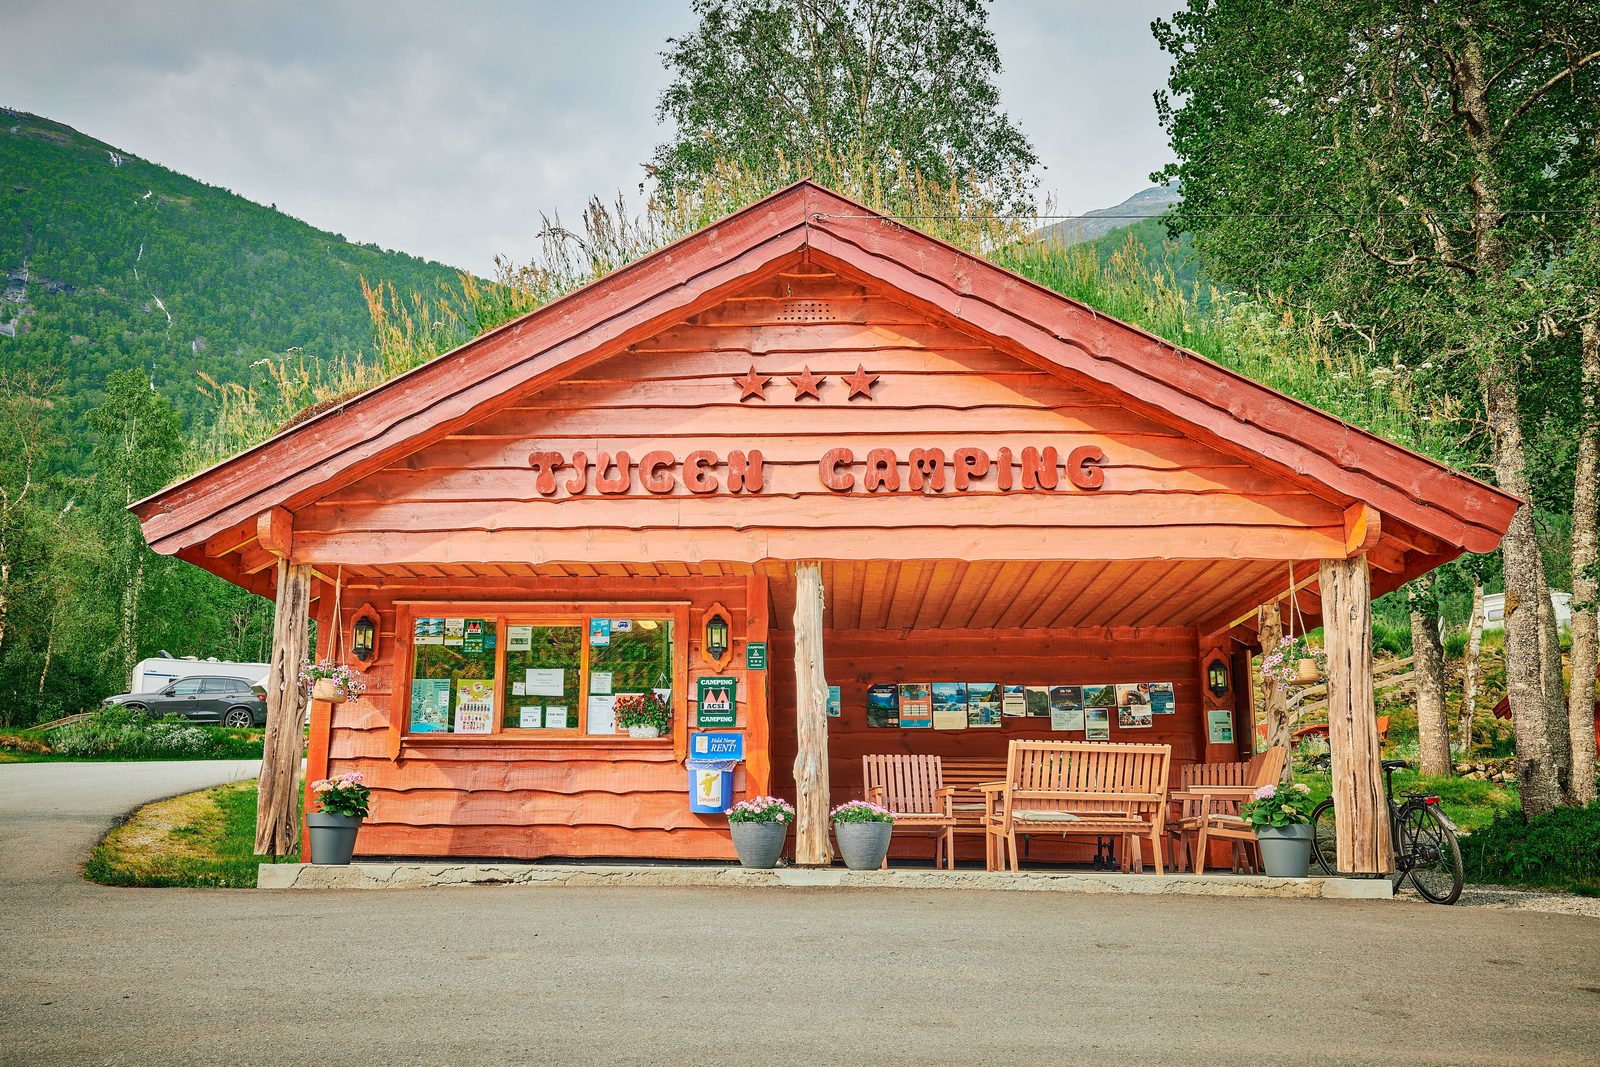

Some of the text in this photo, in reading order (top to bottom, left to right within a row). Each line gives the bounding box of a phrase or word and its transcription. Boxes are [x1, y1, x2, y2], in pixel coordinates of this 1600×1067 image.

[528, 445, 1106, 494] TJUGEN CAMPING
[710, 743, 737, 752] RENT!
